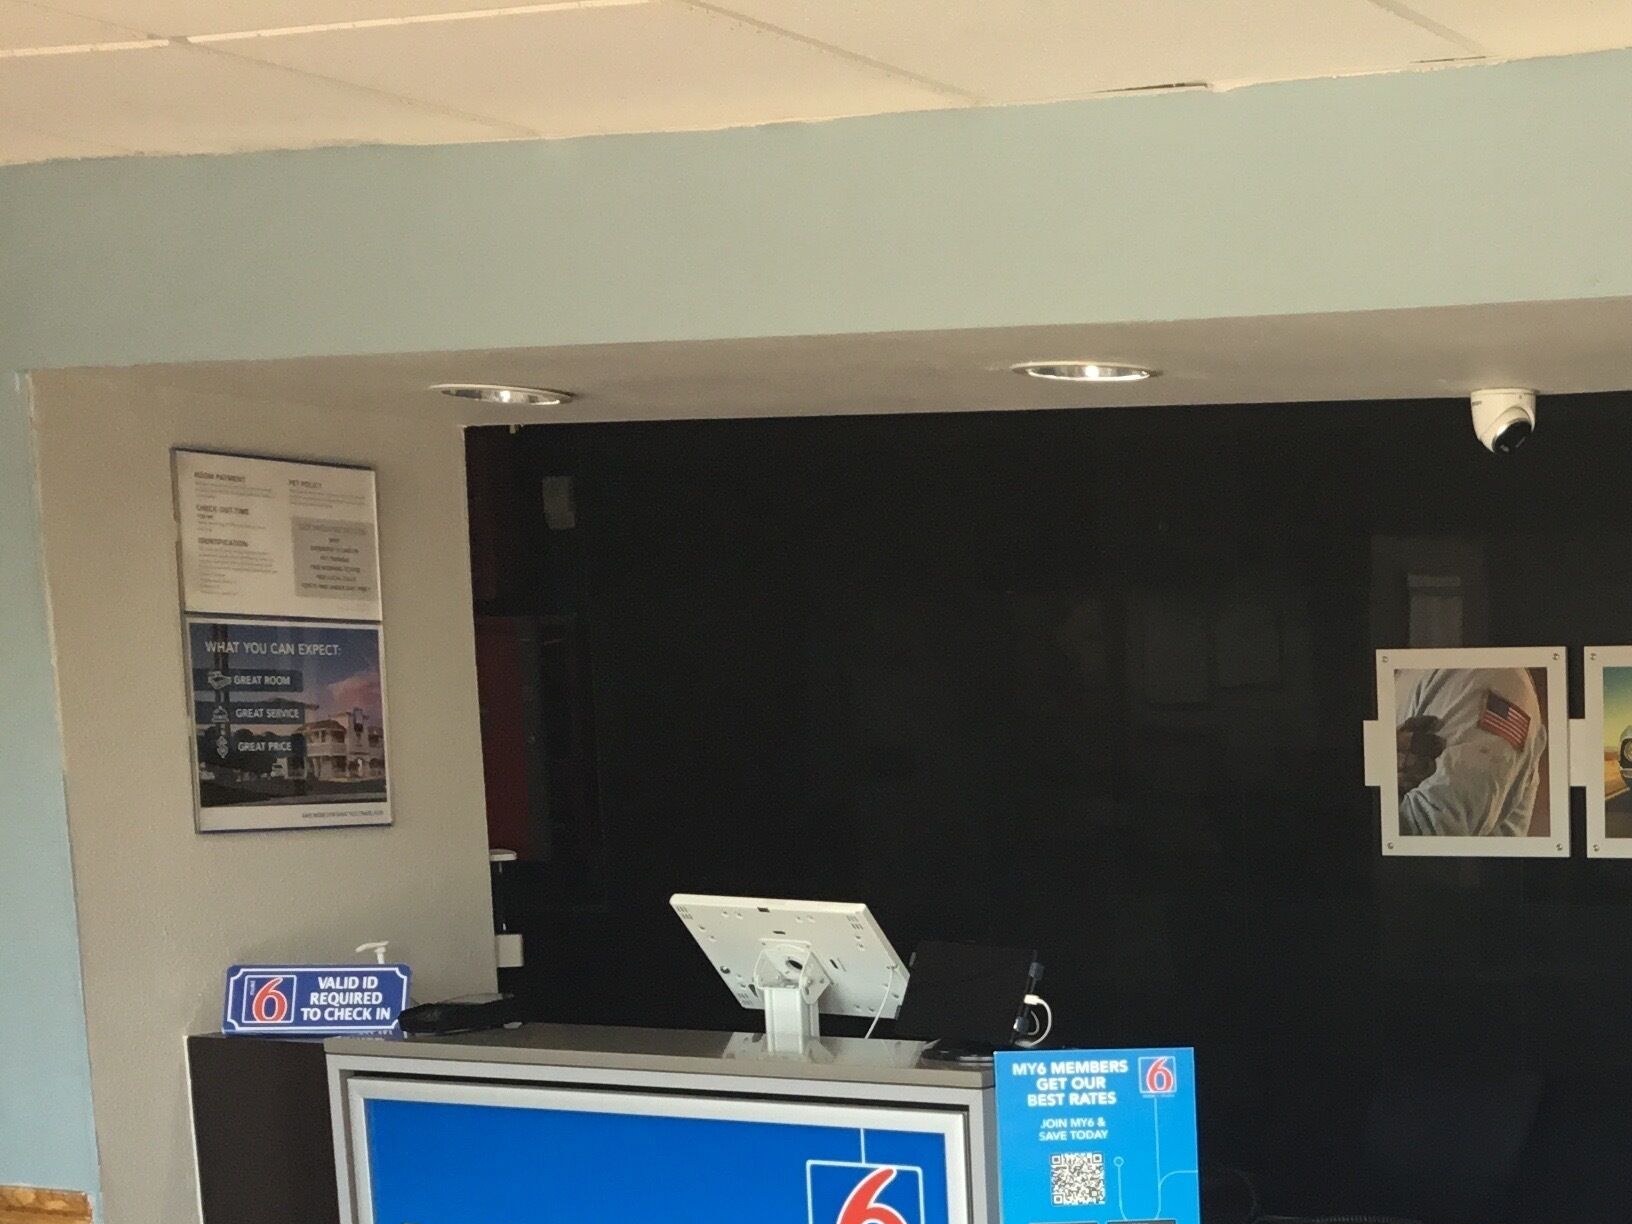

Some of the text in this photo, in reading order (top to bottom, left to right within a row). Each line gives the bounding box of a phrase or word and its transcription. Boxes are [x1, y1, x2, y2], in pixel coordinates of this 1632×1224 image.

[205, 641, 342, 656] WHAT YOU CAN EXPECT:
[234, 675, 290, 685] GREAT ROOM
[235, 708, 299, 719] GREAT SERVICE
[237, 742, 292, 751] GREAT PRICE
[318, 976, 378, 990] VALID ID
[252, 977, 288, 1023] 6
[309, 992, 383, 1006] REQUIRED
[300, 1007, 391, 1021] TO CHECK IN
[1012, 1060, 1128, 1076] MY6 MEMBERS
[1146, 1057, 1173, 1093] 6
[1036, 1076, 1106, 1091] GET OUR
[1027, 1092, 1117, 1107] BEST RATES
[1040, 1117, 1106, 1129] JOIN MY6 &
[1039, 1130, 1108, 1141] SAVE TODAY
